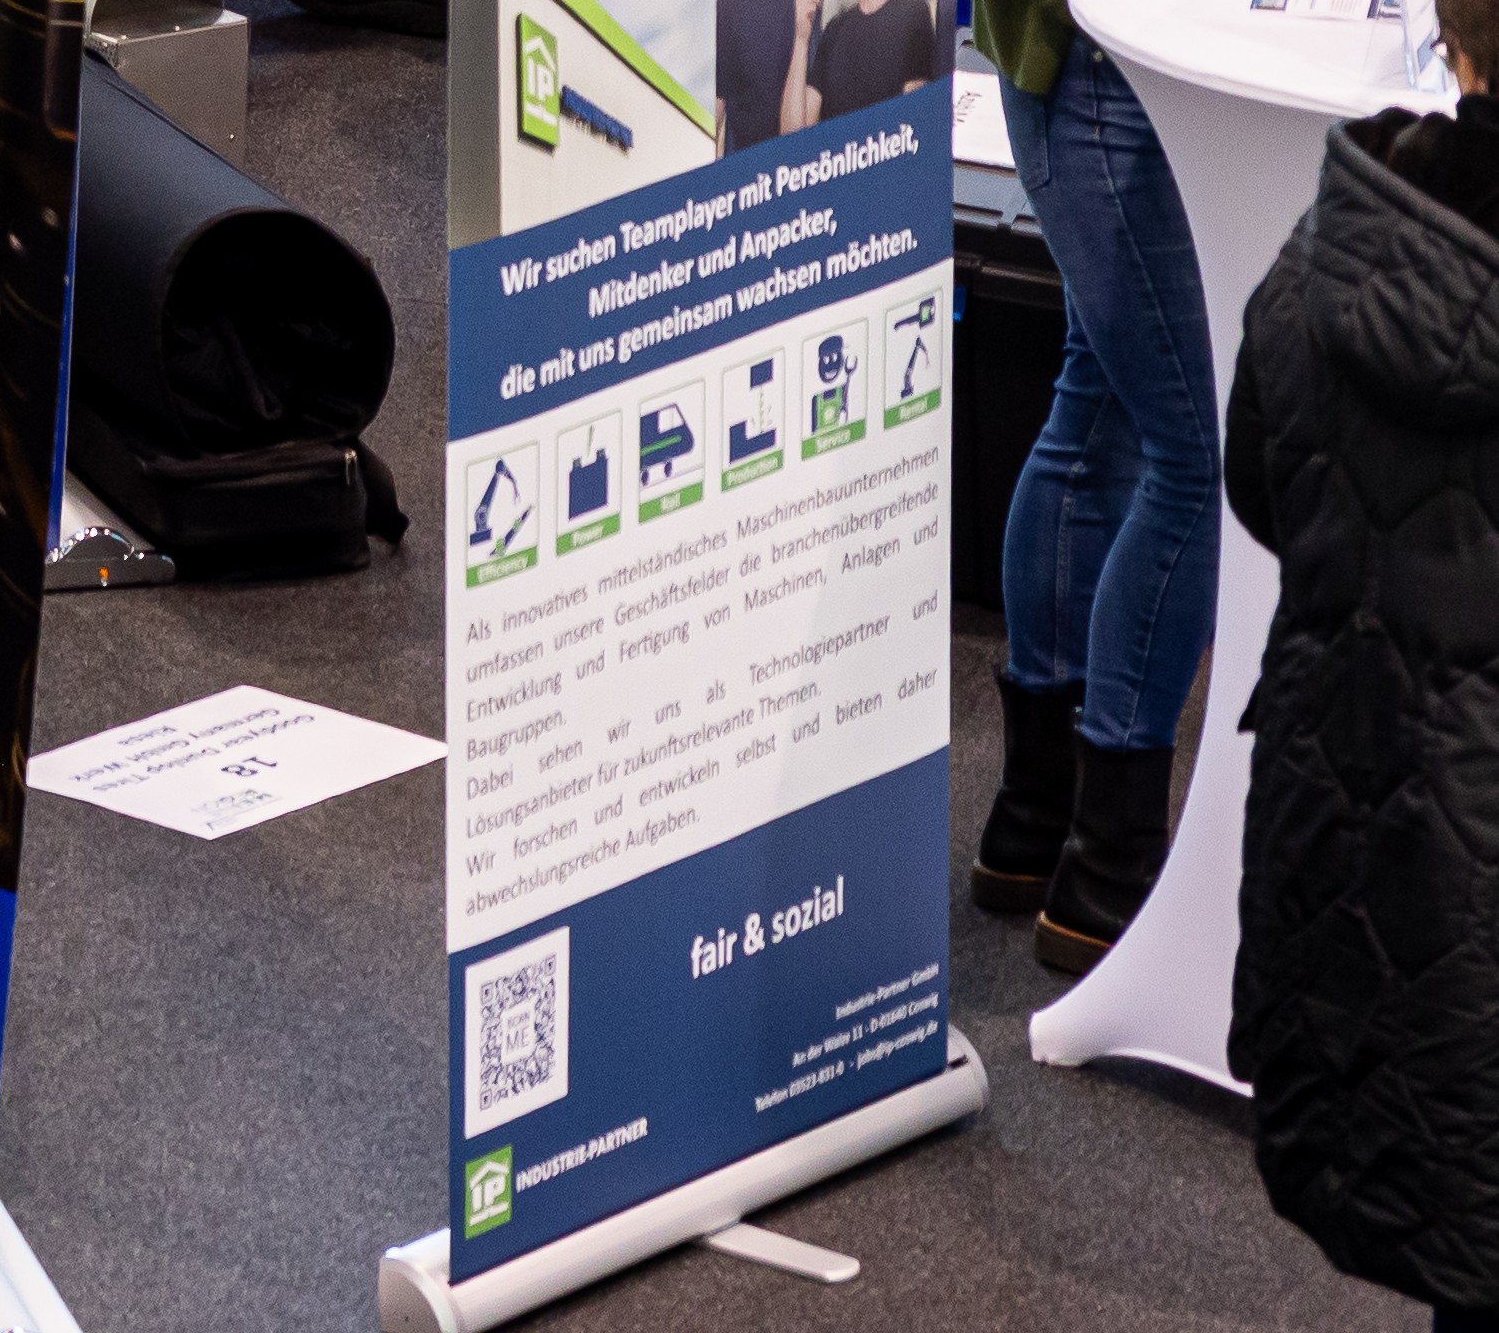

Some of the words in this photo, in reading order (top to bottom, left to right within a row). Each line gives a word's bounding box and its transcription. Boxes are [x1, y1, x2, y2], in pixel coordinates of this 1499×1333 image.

[500, 256, 542, 296] Wir
[545, 233, 616, 282] suchen
[620, 190, 736, 244] Teamplayer
[740, 174, 773, 206] mit
[776, 123, 920, 196] Persönlichkeit,
[221, 756, 278, 778] 18
[691, 929, 738, 980] fair
[743, 913, 766, 957] &
[771, 875, 845, 944] sozial
